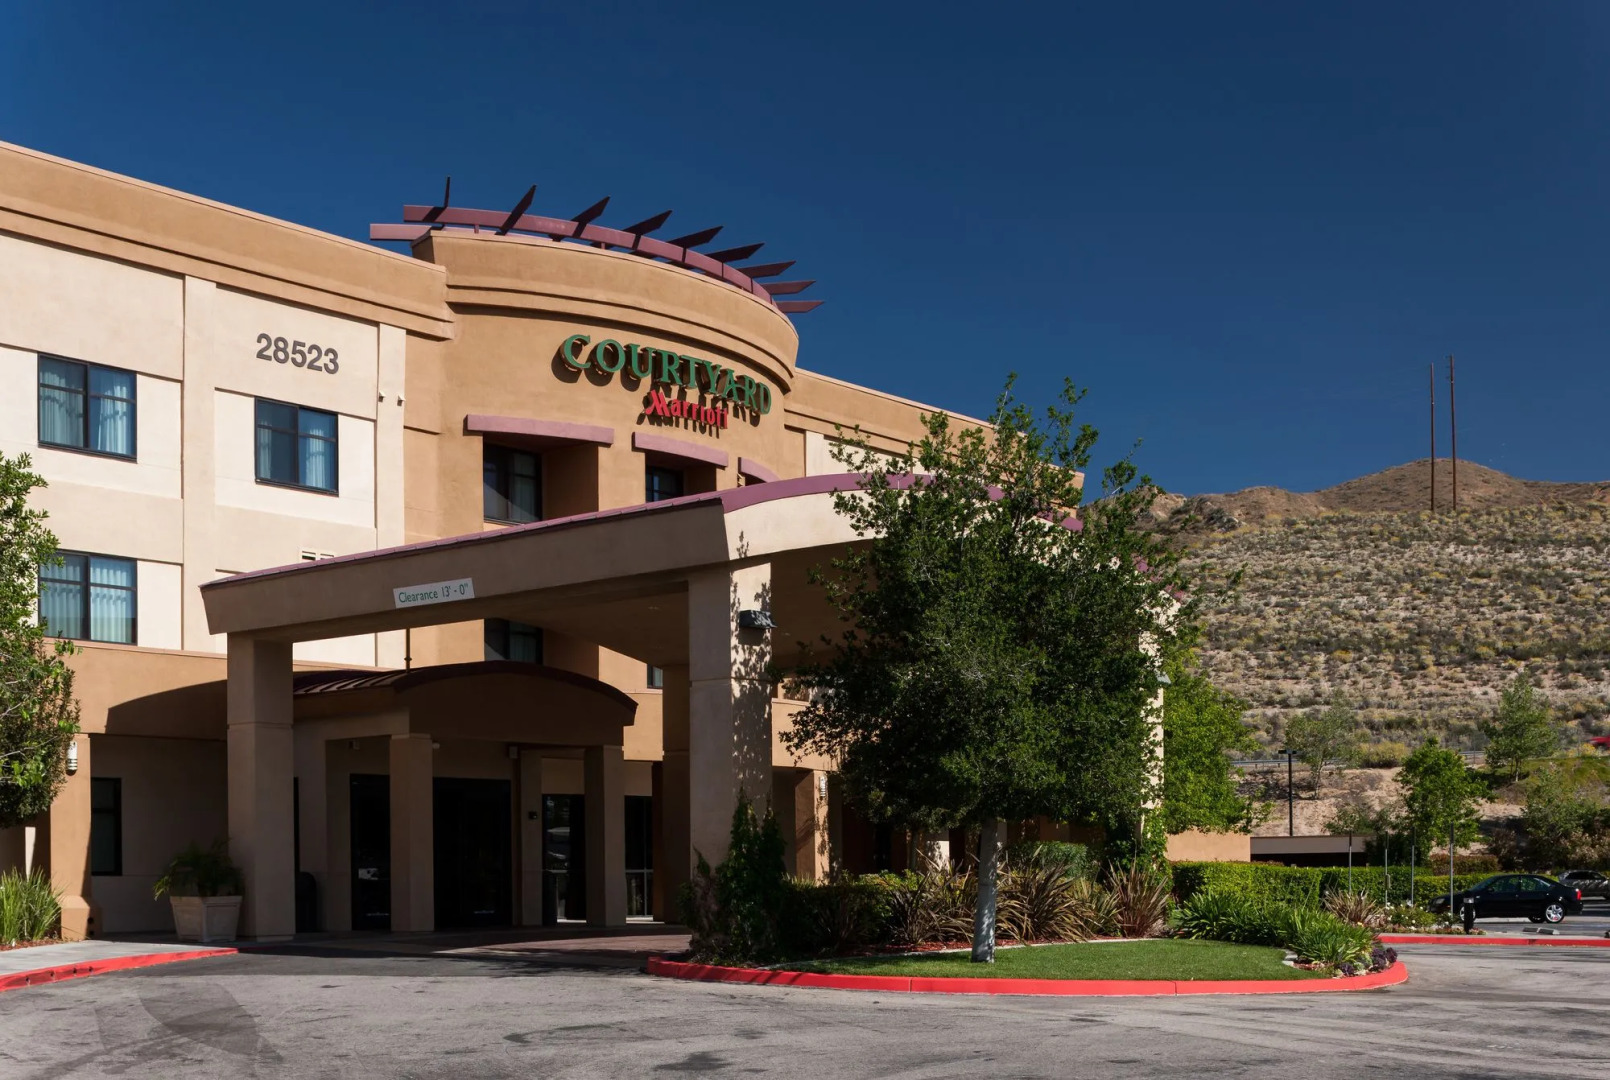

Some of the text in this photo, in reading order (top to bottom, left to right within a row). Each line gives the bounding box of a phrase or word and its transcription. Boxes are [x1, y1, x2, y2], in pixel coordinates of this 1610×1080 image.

[257, 334, 339, 374] 28523
[563, 334, 771, 415] COURTYARD
[645, 389, 728, 430] Marriott
[398, 591, 438, 603] Clearance
